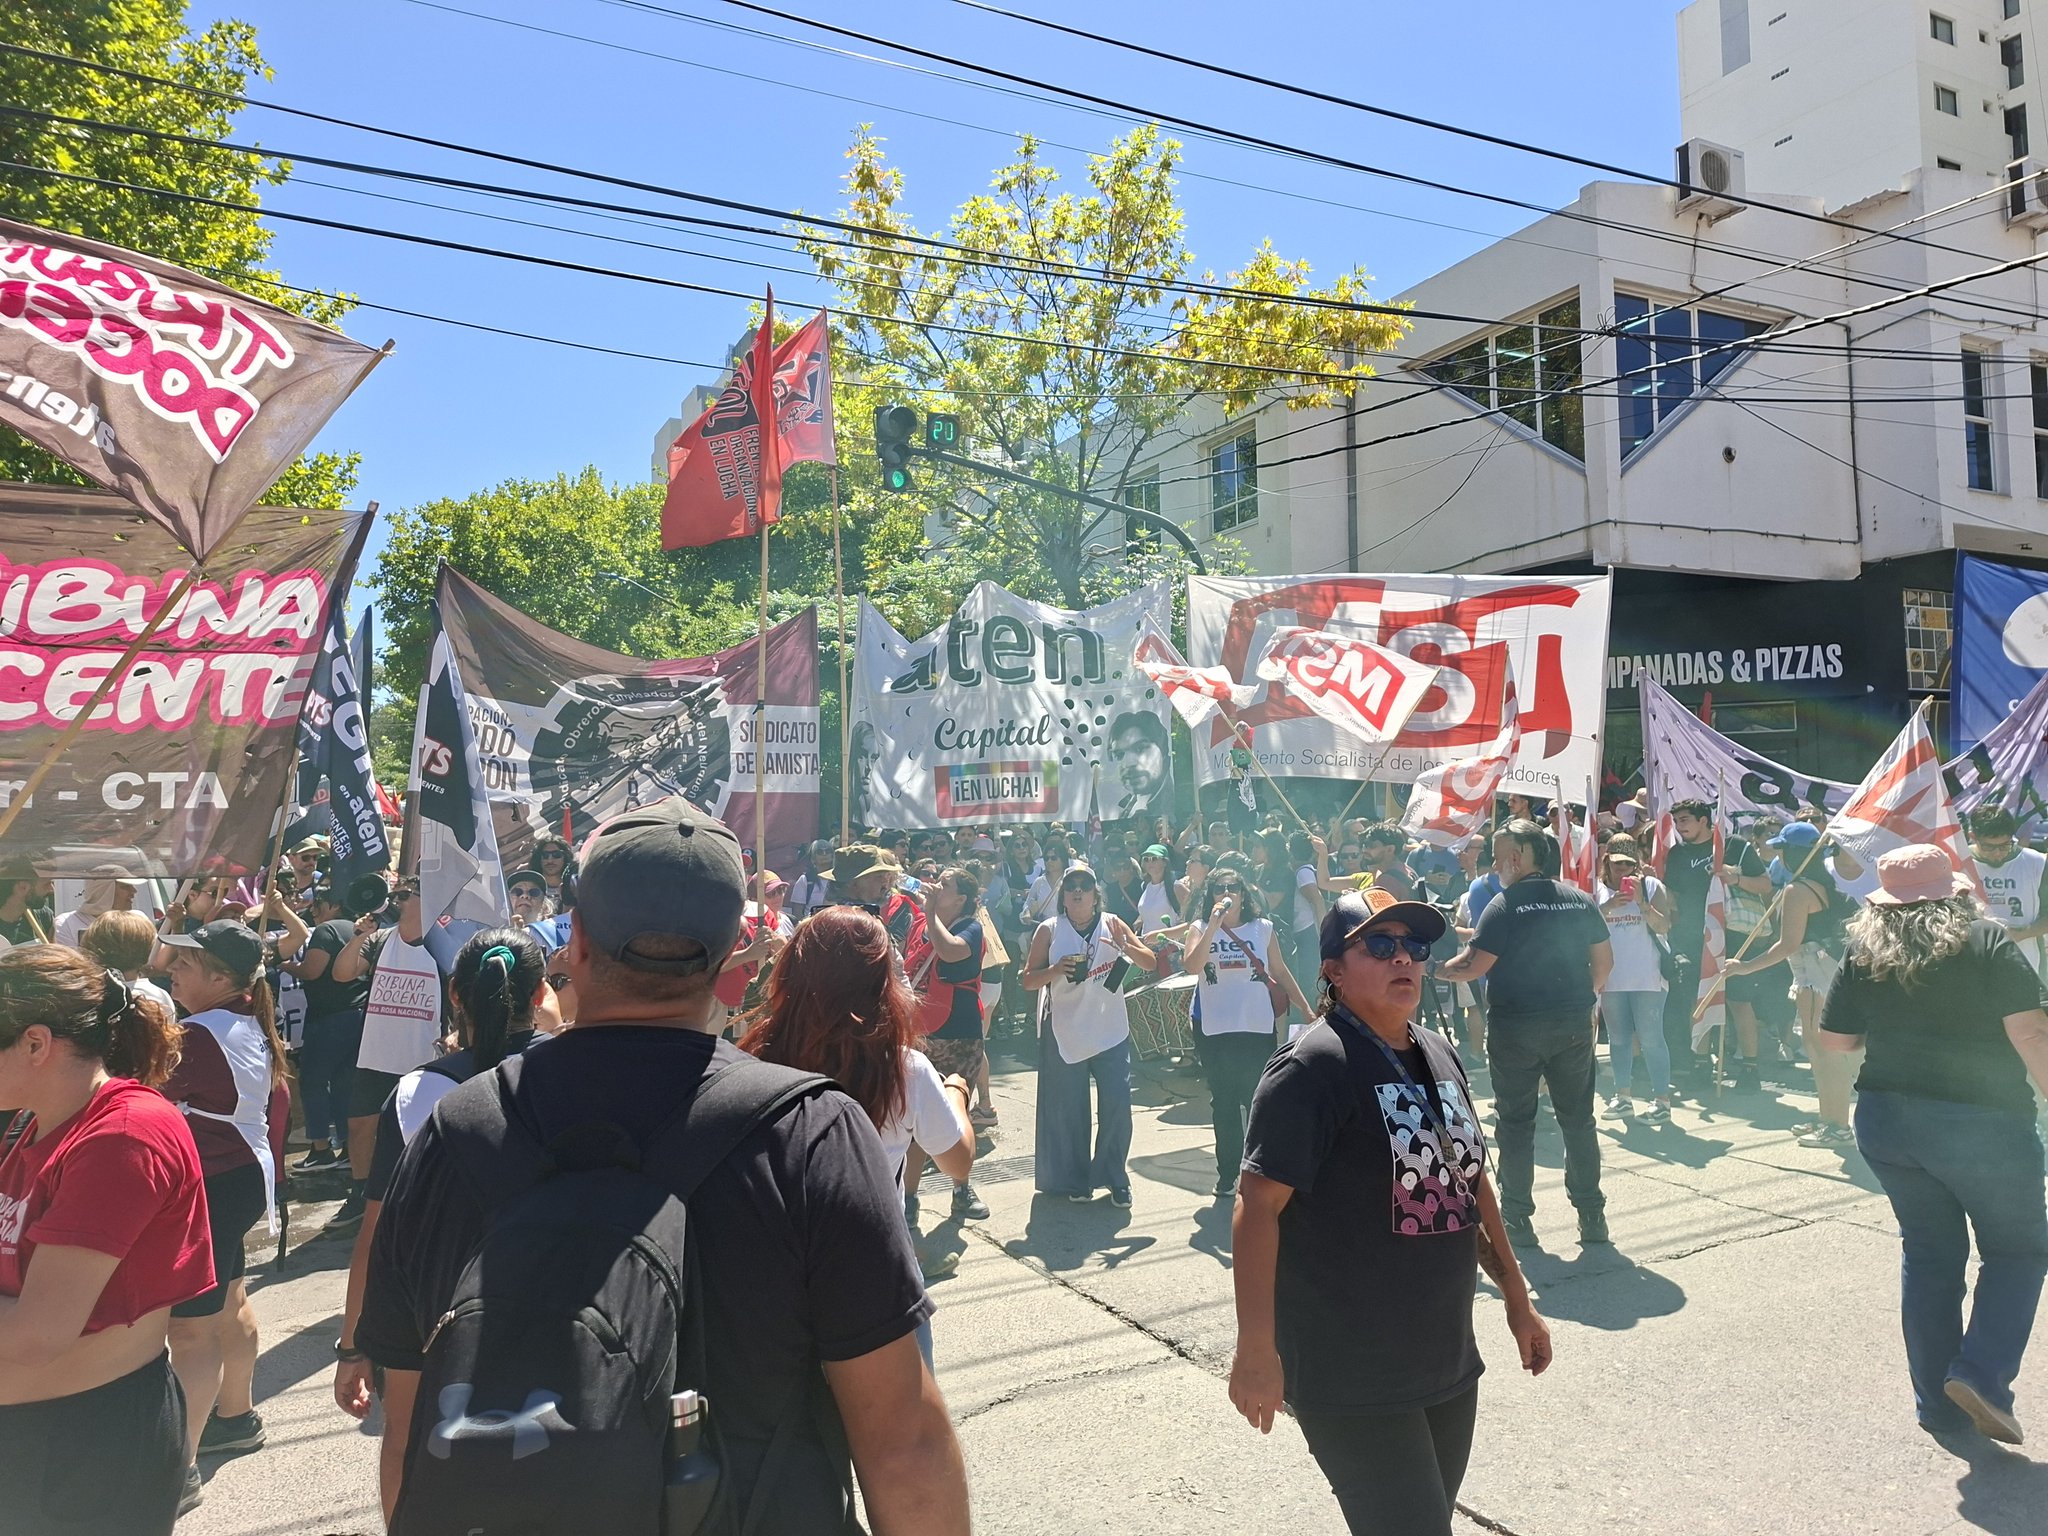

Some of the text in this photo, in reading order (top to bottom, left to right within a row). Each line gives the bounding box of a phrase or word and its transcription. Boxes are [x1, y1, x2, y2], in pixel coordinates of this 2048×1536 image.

[709, 438, 740, 501] EN LUCHA
[1607, 644, 1844, 689] MPANADAS & PIZZAS
[608, 690, 676, 703] Empleados
[696, 721, 708, 740] del
[739, 720, 817, 744] SIDICATO
[934, 713, 1052, 758] Capital
[420, 736, 452, 777] TS
[735, 752, 819, 775] CEAMISTA
[1301, 749, 1384, 771] Socialista
[1390, 754, 1413, 771] de
[102, 771, 229, 810] CTA
[986, 775, 1040, 801] LUCHA!
[339, 784, 384, 857] en aten
[1983, 876, 2017, 889] ten
[373, 973, 426, 991] TRIBUNA
[374, 987, 435, 1008] DOCENTE
[380, 1005, 397, 1014] ROSA
[397, 1007, 429, 1020] NACIONAL
